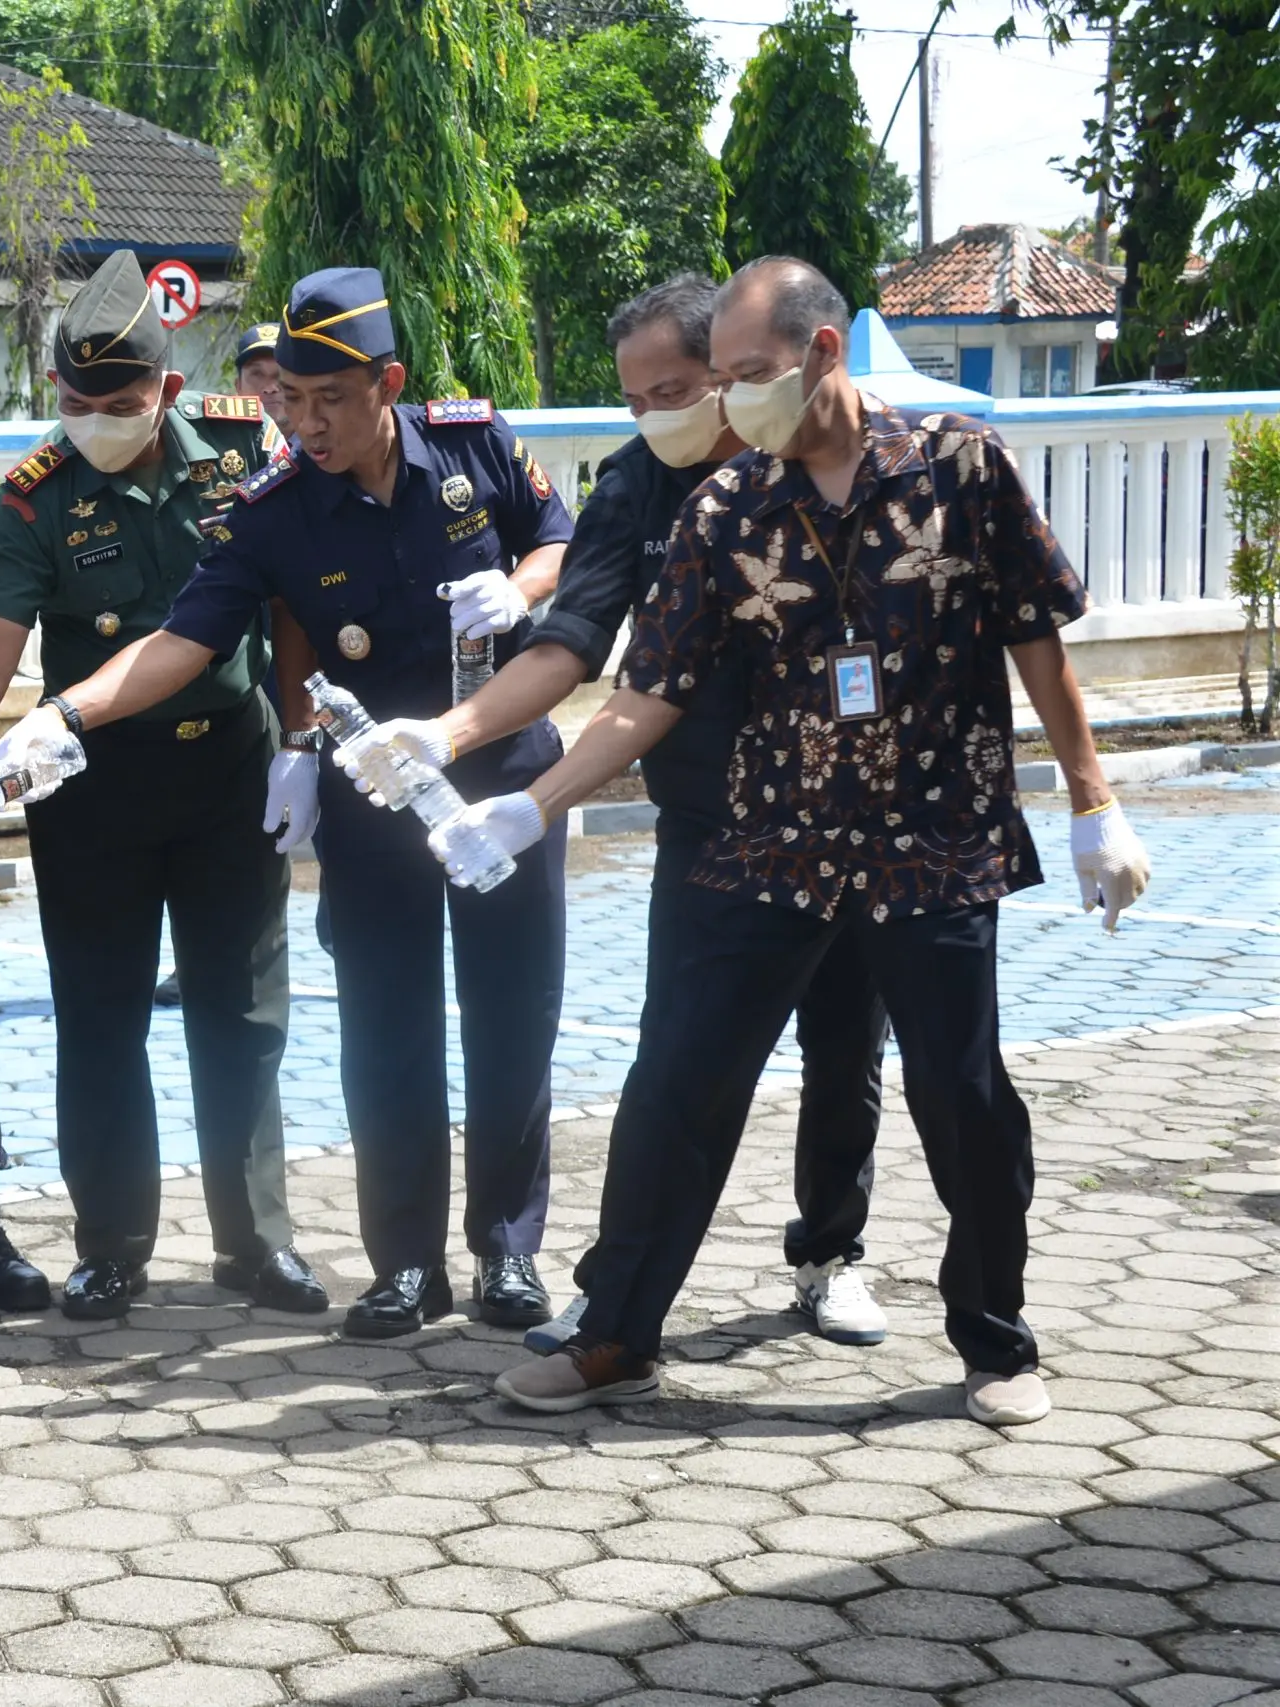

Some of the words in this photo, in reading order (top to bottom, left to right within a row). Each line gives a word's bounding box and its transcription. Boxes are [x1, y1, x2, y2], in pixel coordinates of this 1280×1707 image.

[163, 277, 186, 314] P
[12, 470, 31, 488] TNI
[446, 509, 488, 533] CUSTOMS
[320, 571, 347, 586] DWI
